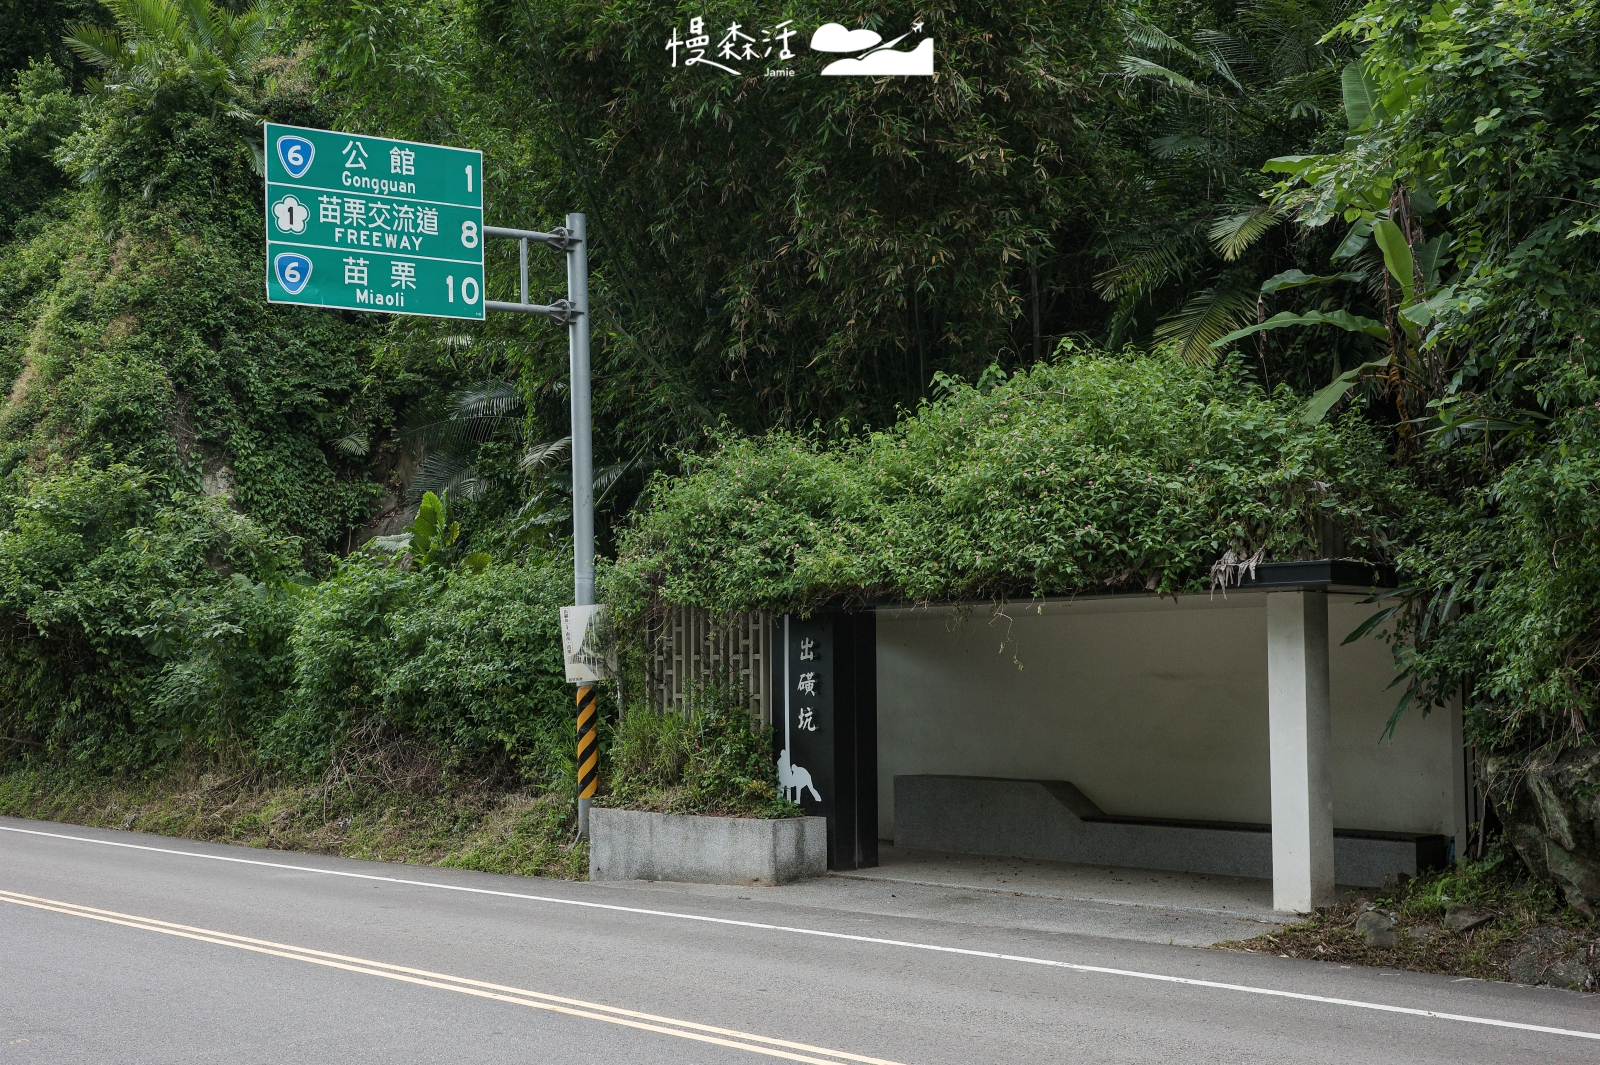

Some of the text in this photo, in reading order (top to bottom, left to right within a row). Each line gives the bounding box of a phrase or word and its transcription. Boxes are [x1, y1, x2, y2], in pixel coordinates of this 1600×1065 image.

[287, 145, 304, 166] 6
[342, 140, 415, 176] 公館
[341, 171, 416, 195] Gongguan
[464, 164, 473, 193] 1
[287, 206, 294, 226] 1
[317, 194, 439, 236] 苗栗交流道
[334, 227, 423, 251] FREEWAY
[460, 220, 479, 249] 8
[284, 261, 301, 283] 6
[342, 256, 417, 290] 苗栗
[355, 288, 405, 307] Miaoli
[445, 275, 480, 305] 10
[797, 636, 817, 732] 出磺坑
